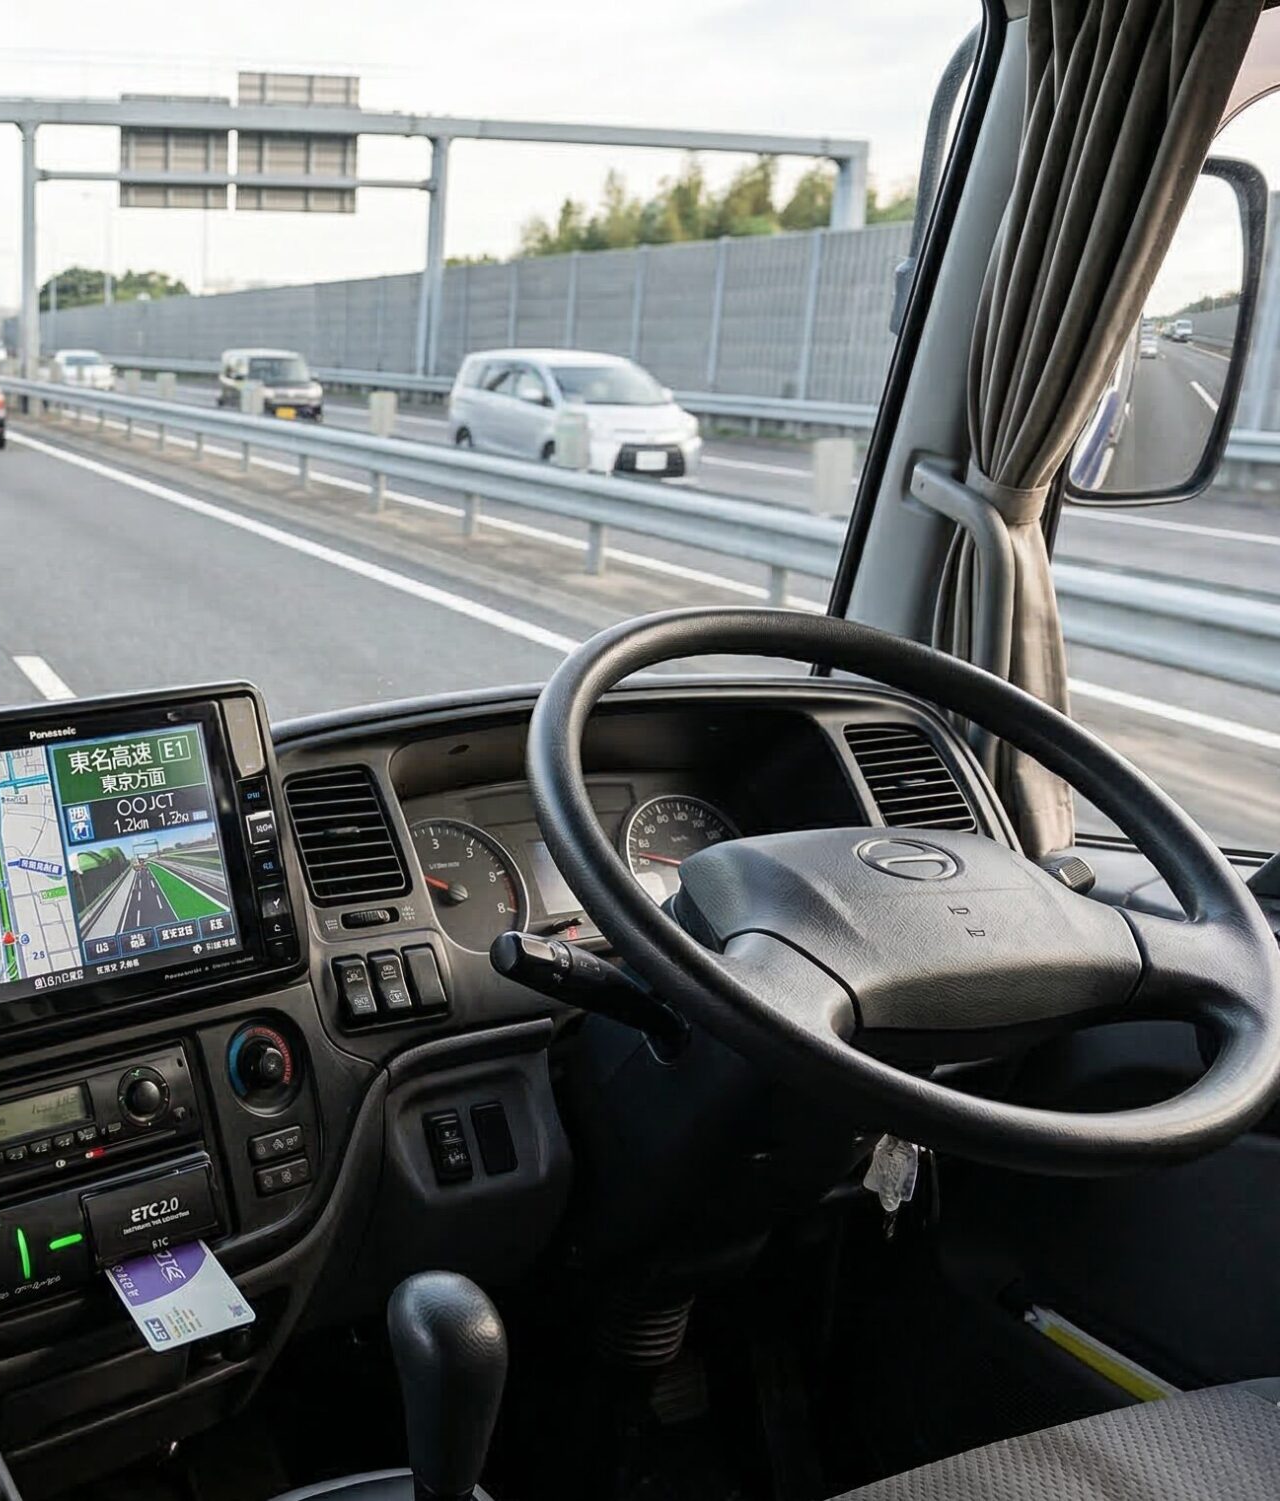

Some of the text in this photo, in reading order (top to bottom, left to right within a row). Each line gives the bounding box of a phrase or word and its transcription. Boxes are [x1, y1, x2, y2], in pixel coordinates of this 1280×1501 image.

[67, 740, 184, 775] 東名高速 E1
[100, 767, 167, 794] 東京方面
